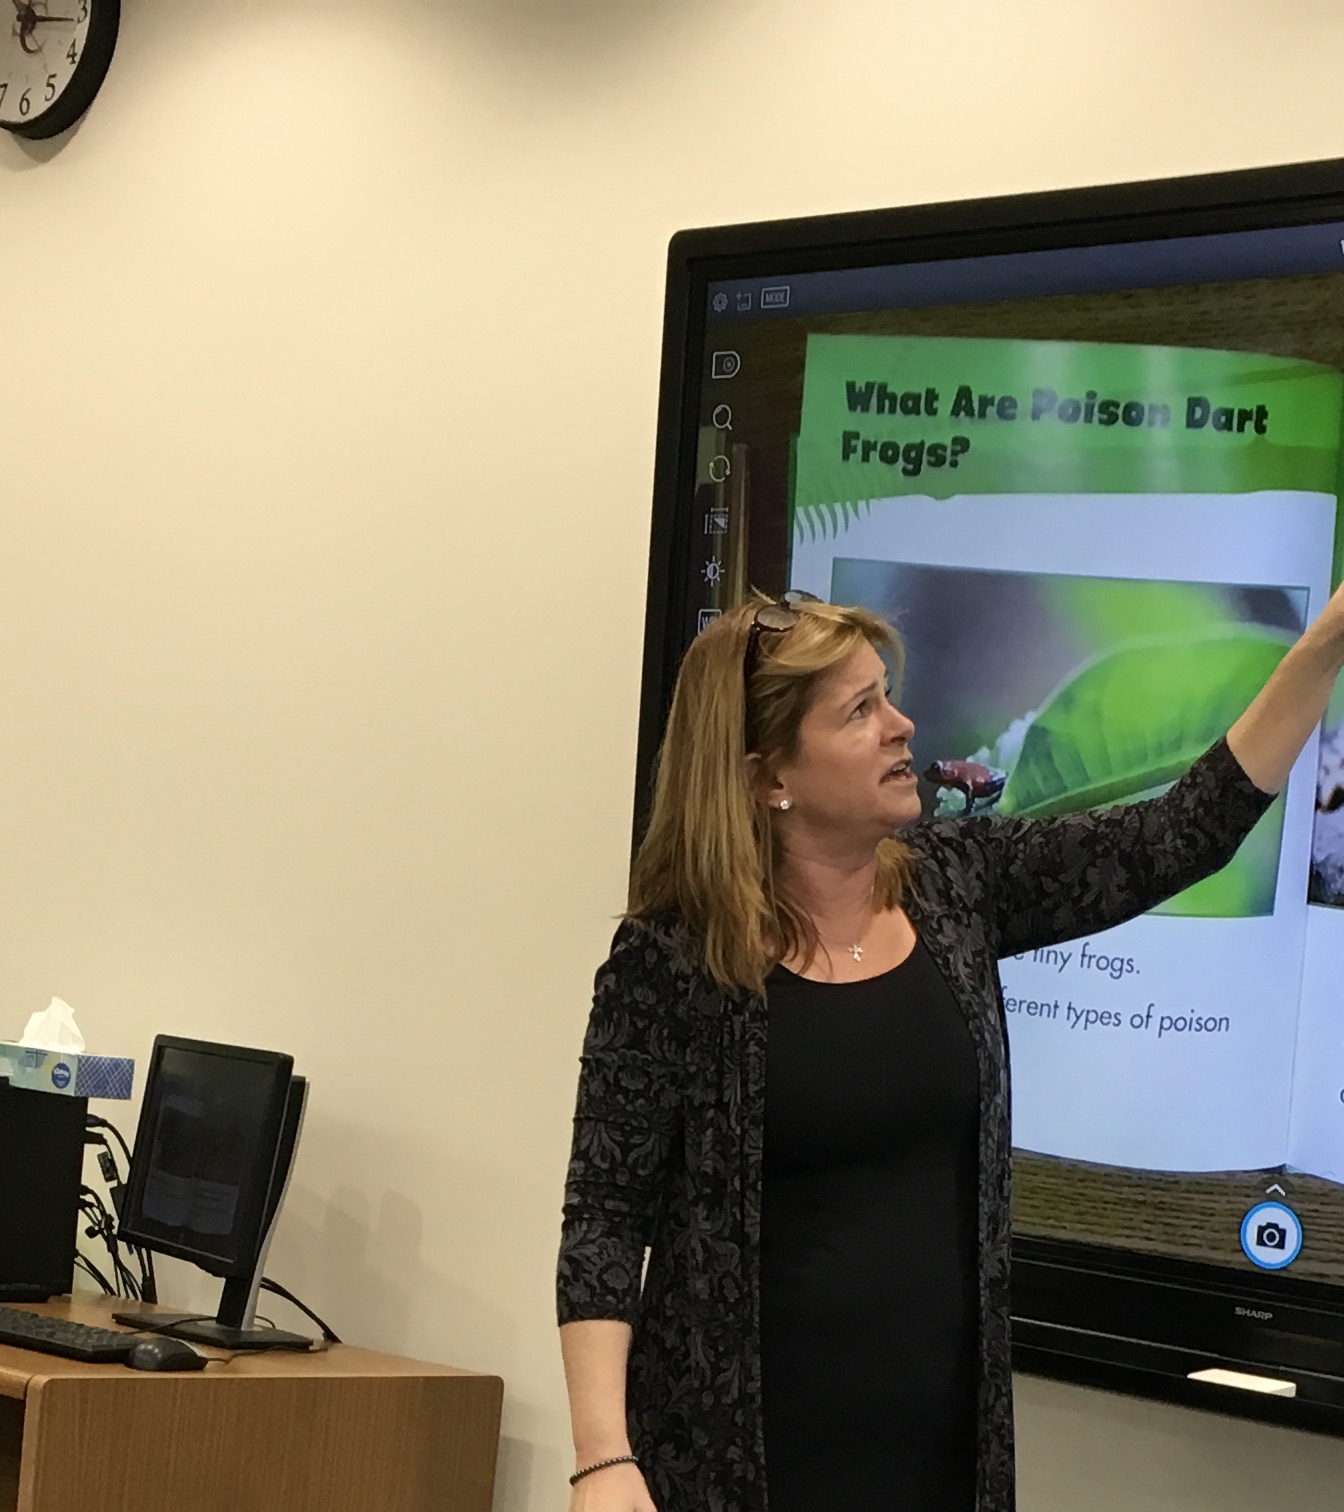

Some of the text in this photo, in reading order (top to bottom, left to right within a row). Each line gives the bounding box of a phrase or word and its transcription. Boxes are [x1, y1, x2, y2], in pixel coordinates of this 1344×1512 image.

[65, 38, 78, 65] 4
[18, 87, 32, 117] 6
[44, 73, 58, 102] 5
[845, 380, 1270, 436] What Are Poison Dart
[841, 429, 971, 478] Frogs?
[1079, 941, 1141, 980] frogs.
[1066, 1001, 1122, 1031] types
[1129, 1002, 1155, 1030] of
[1157, 1008, 1230, 1039] poison
[1234, 1306, 1274, 1321] SHARP
